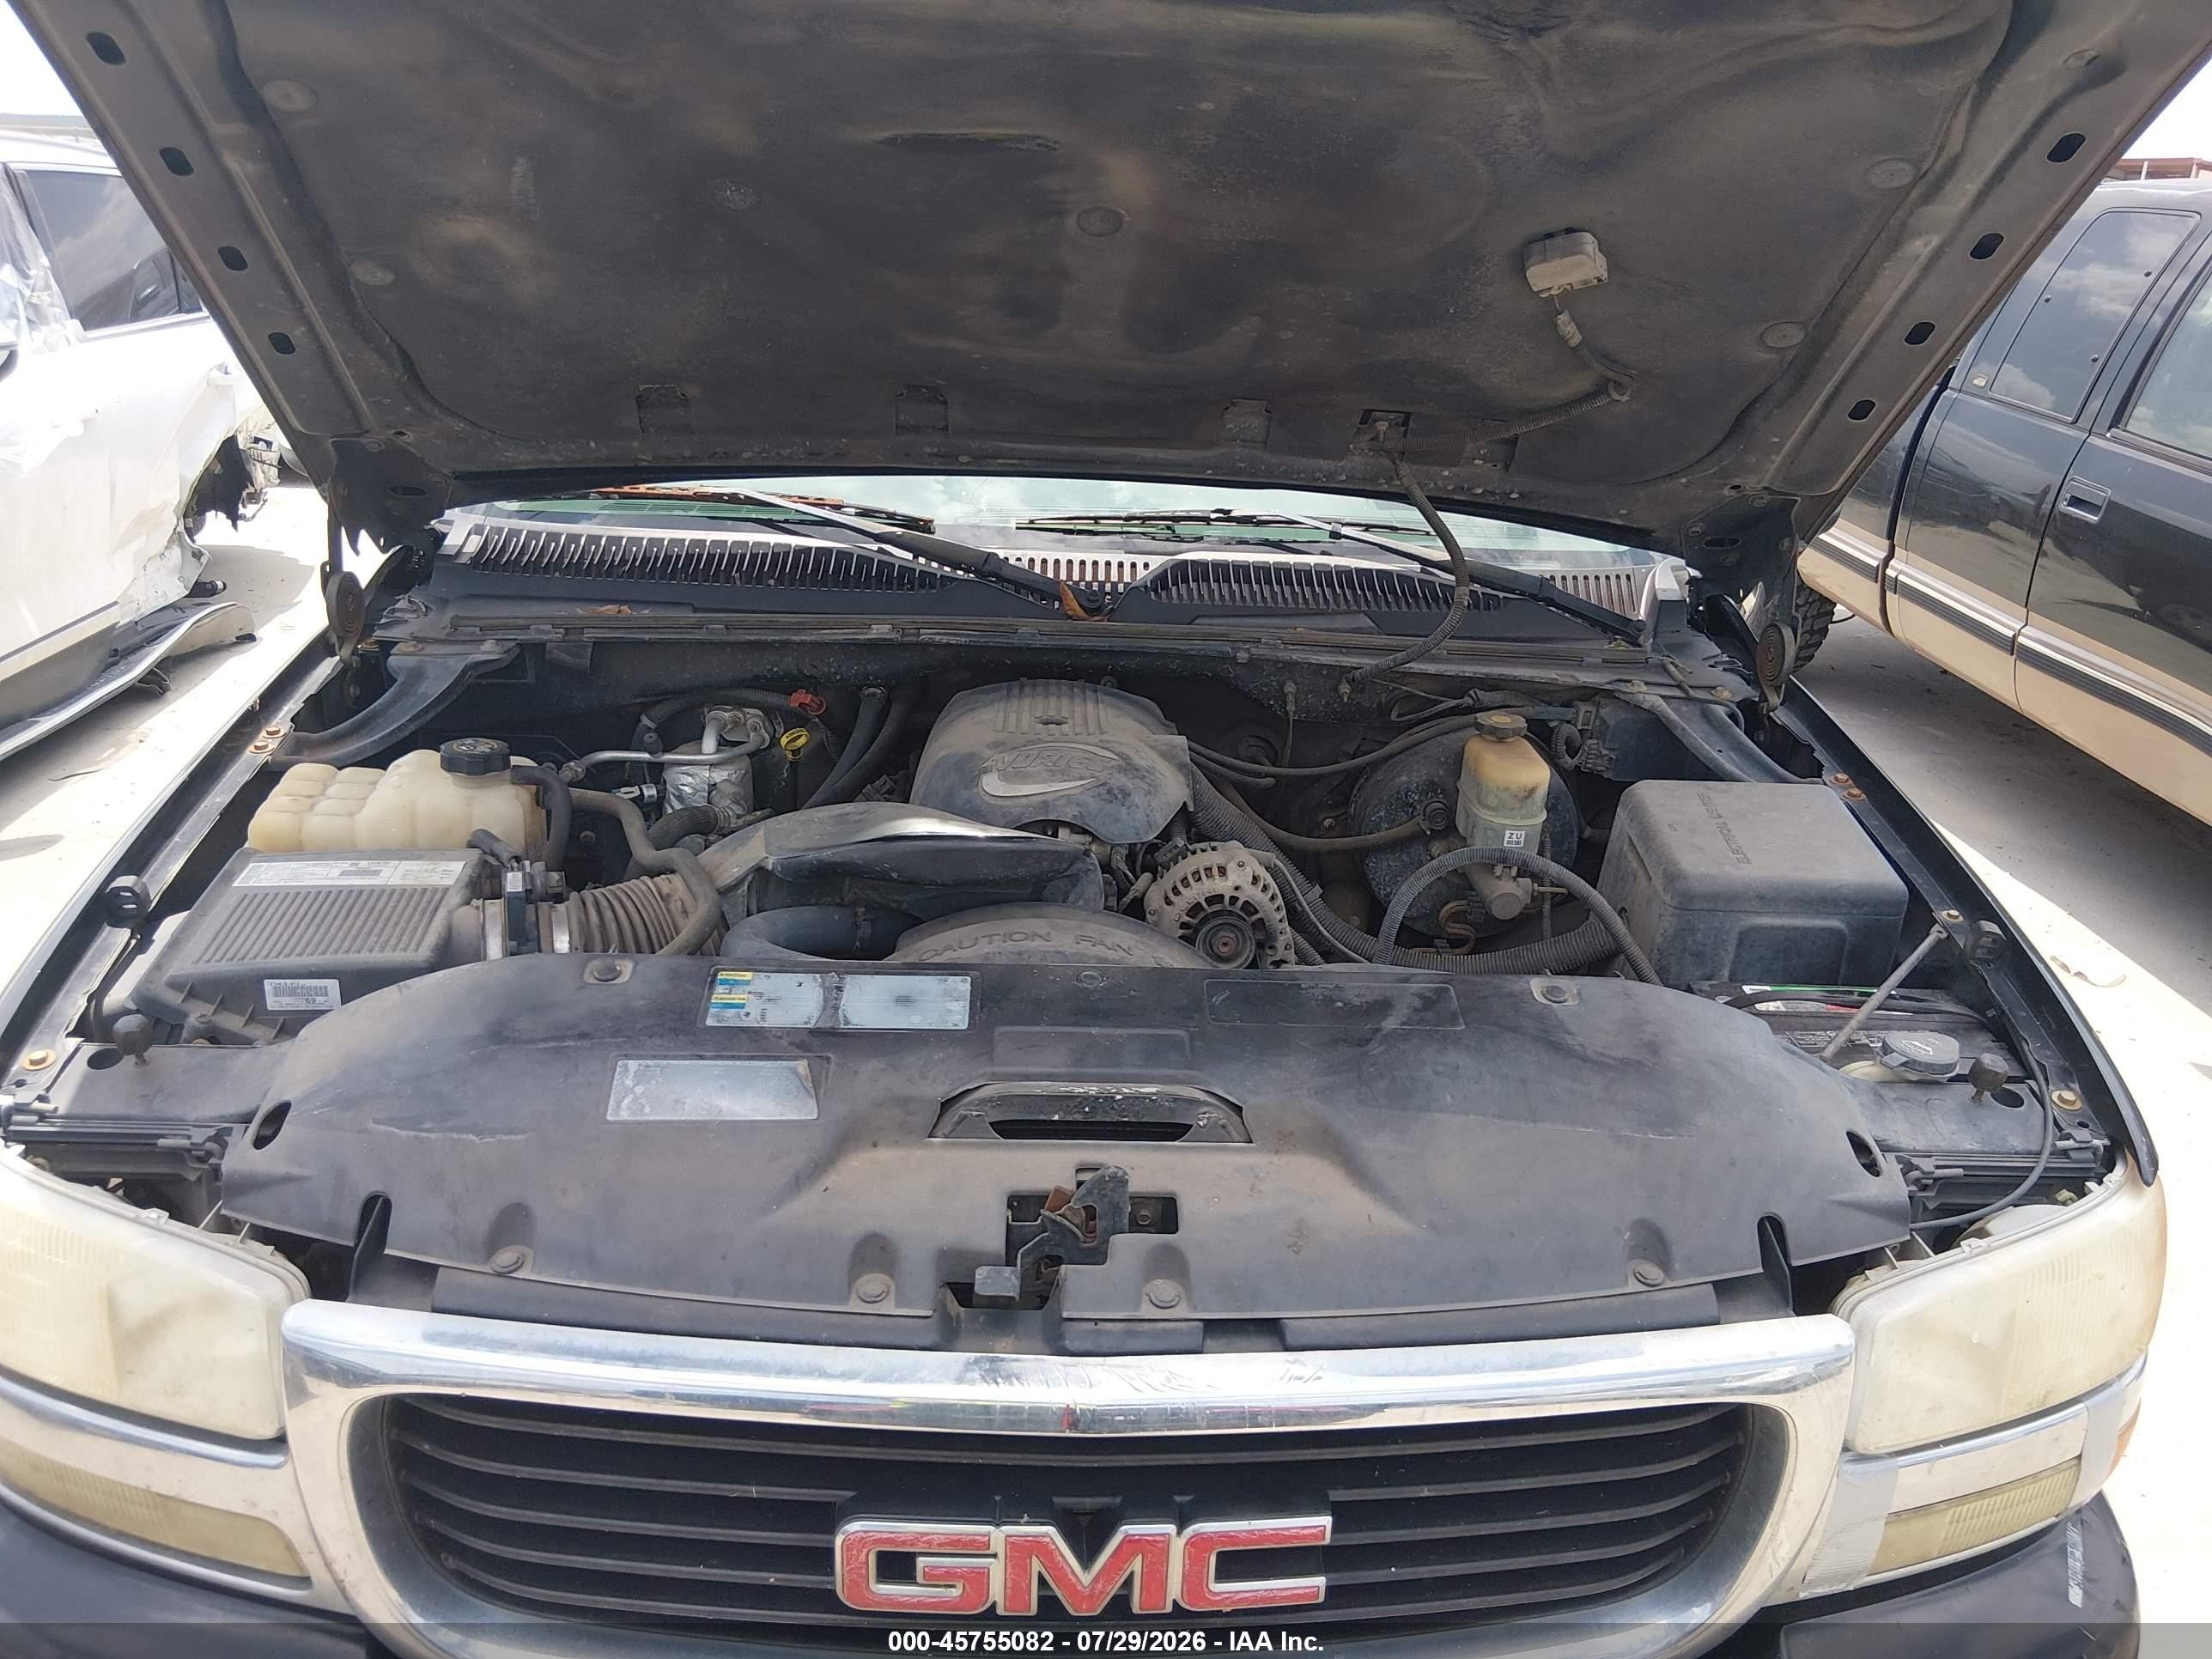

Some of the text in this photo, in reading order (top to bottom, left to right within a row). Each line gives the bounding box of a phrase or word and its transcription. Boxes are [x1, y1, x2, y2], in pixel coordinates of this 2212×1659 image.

[918, 933, 1133, 961] CAUTION FAN
[836, 1516, 1332, 1615] GMC
